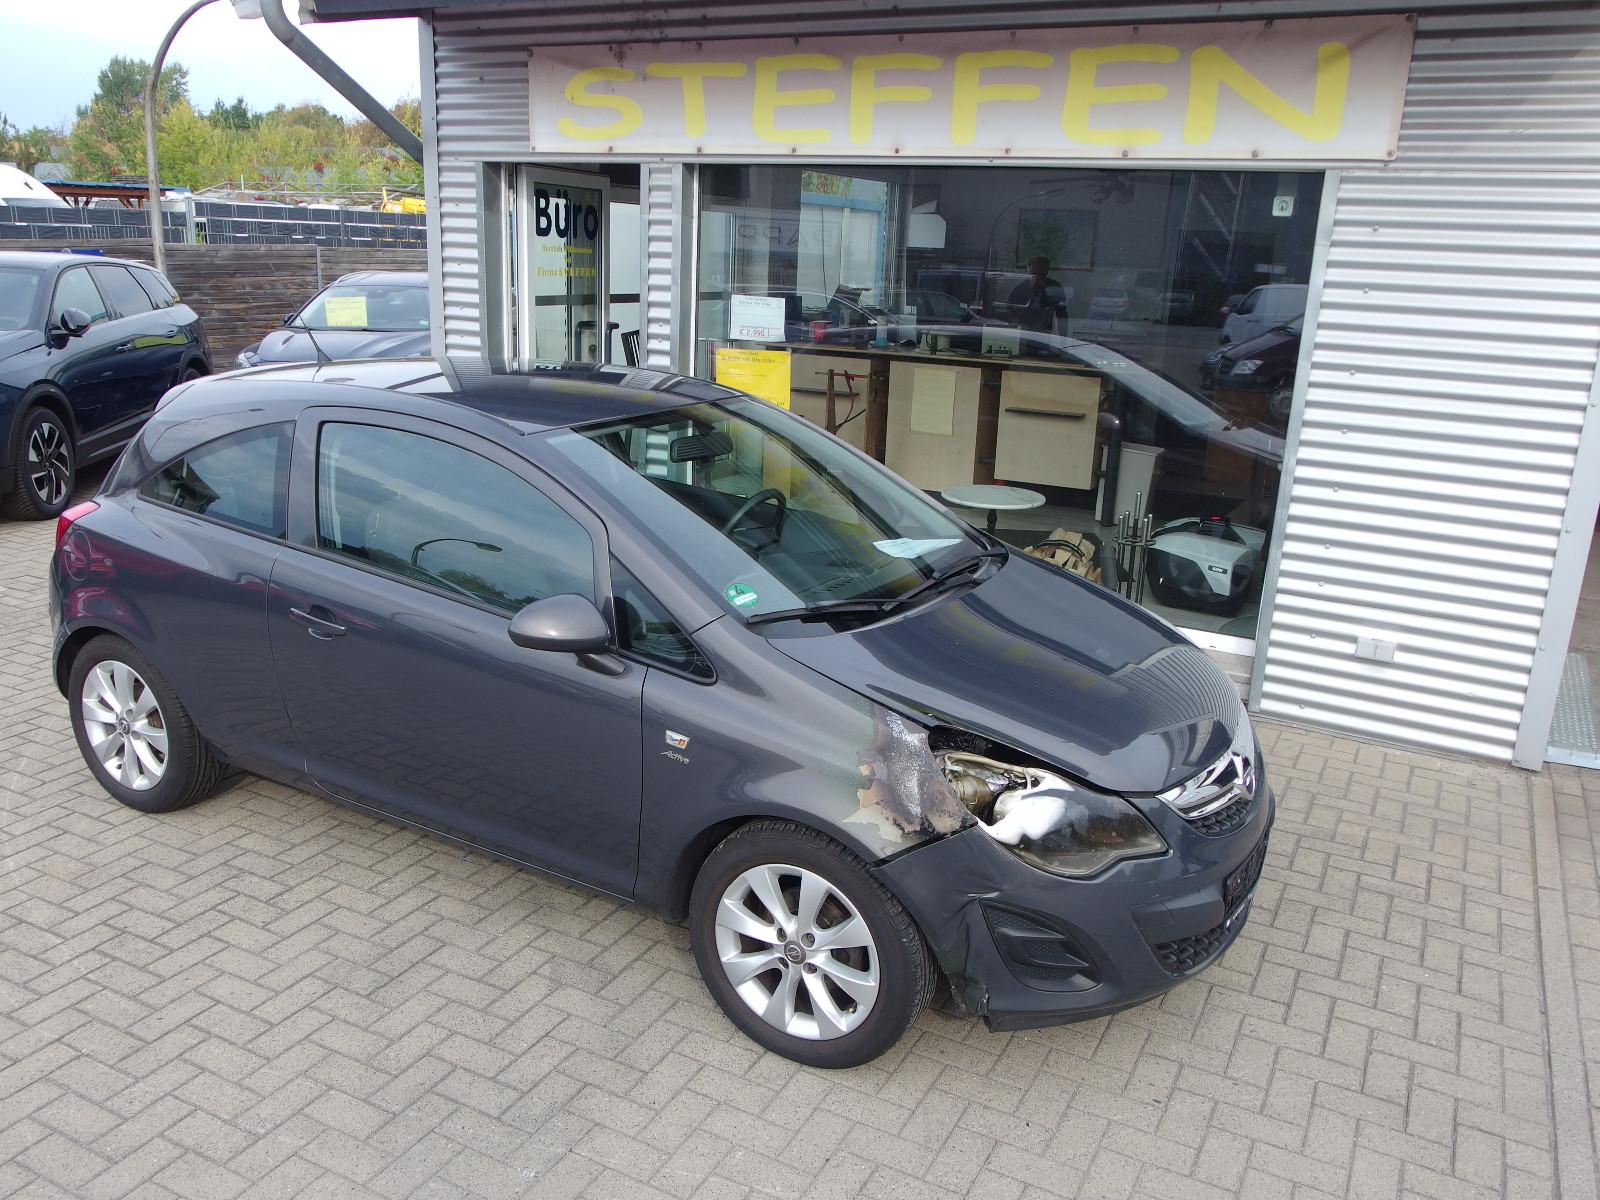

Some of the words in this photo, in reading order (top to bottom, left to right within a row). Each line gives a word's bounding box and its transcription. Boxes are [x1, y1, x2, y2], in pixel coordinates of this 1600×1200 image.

[556, 42, 1351, 146] STEFFEN
[534, 188, 598, 240] Büro
[660, 750, 690, 765] Active
